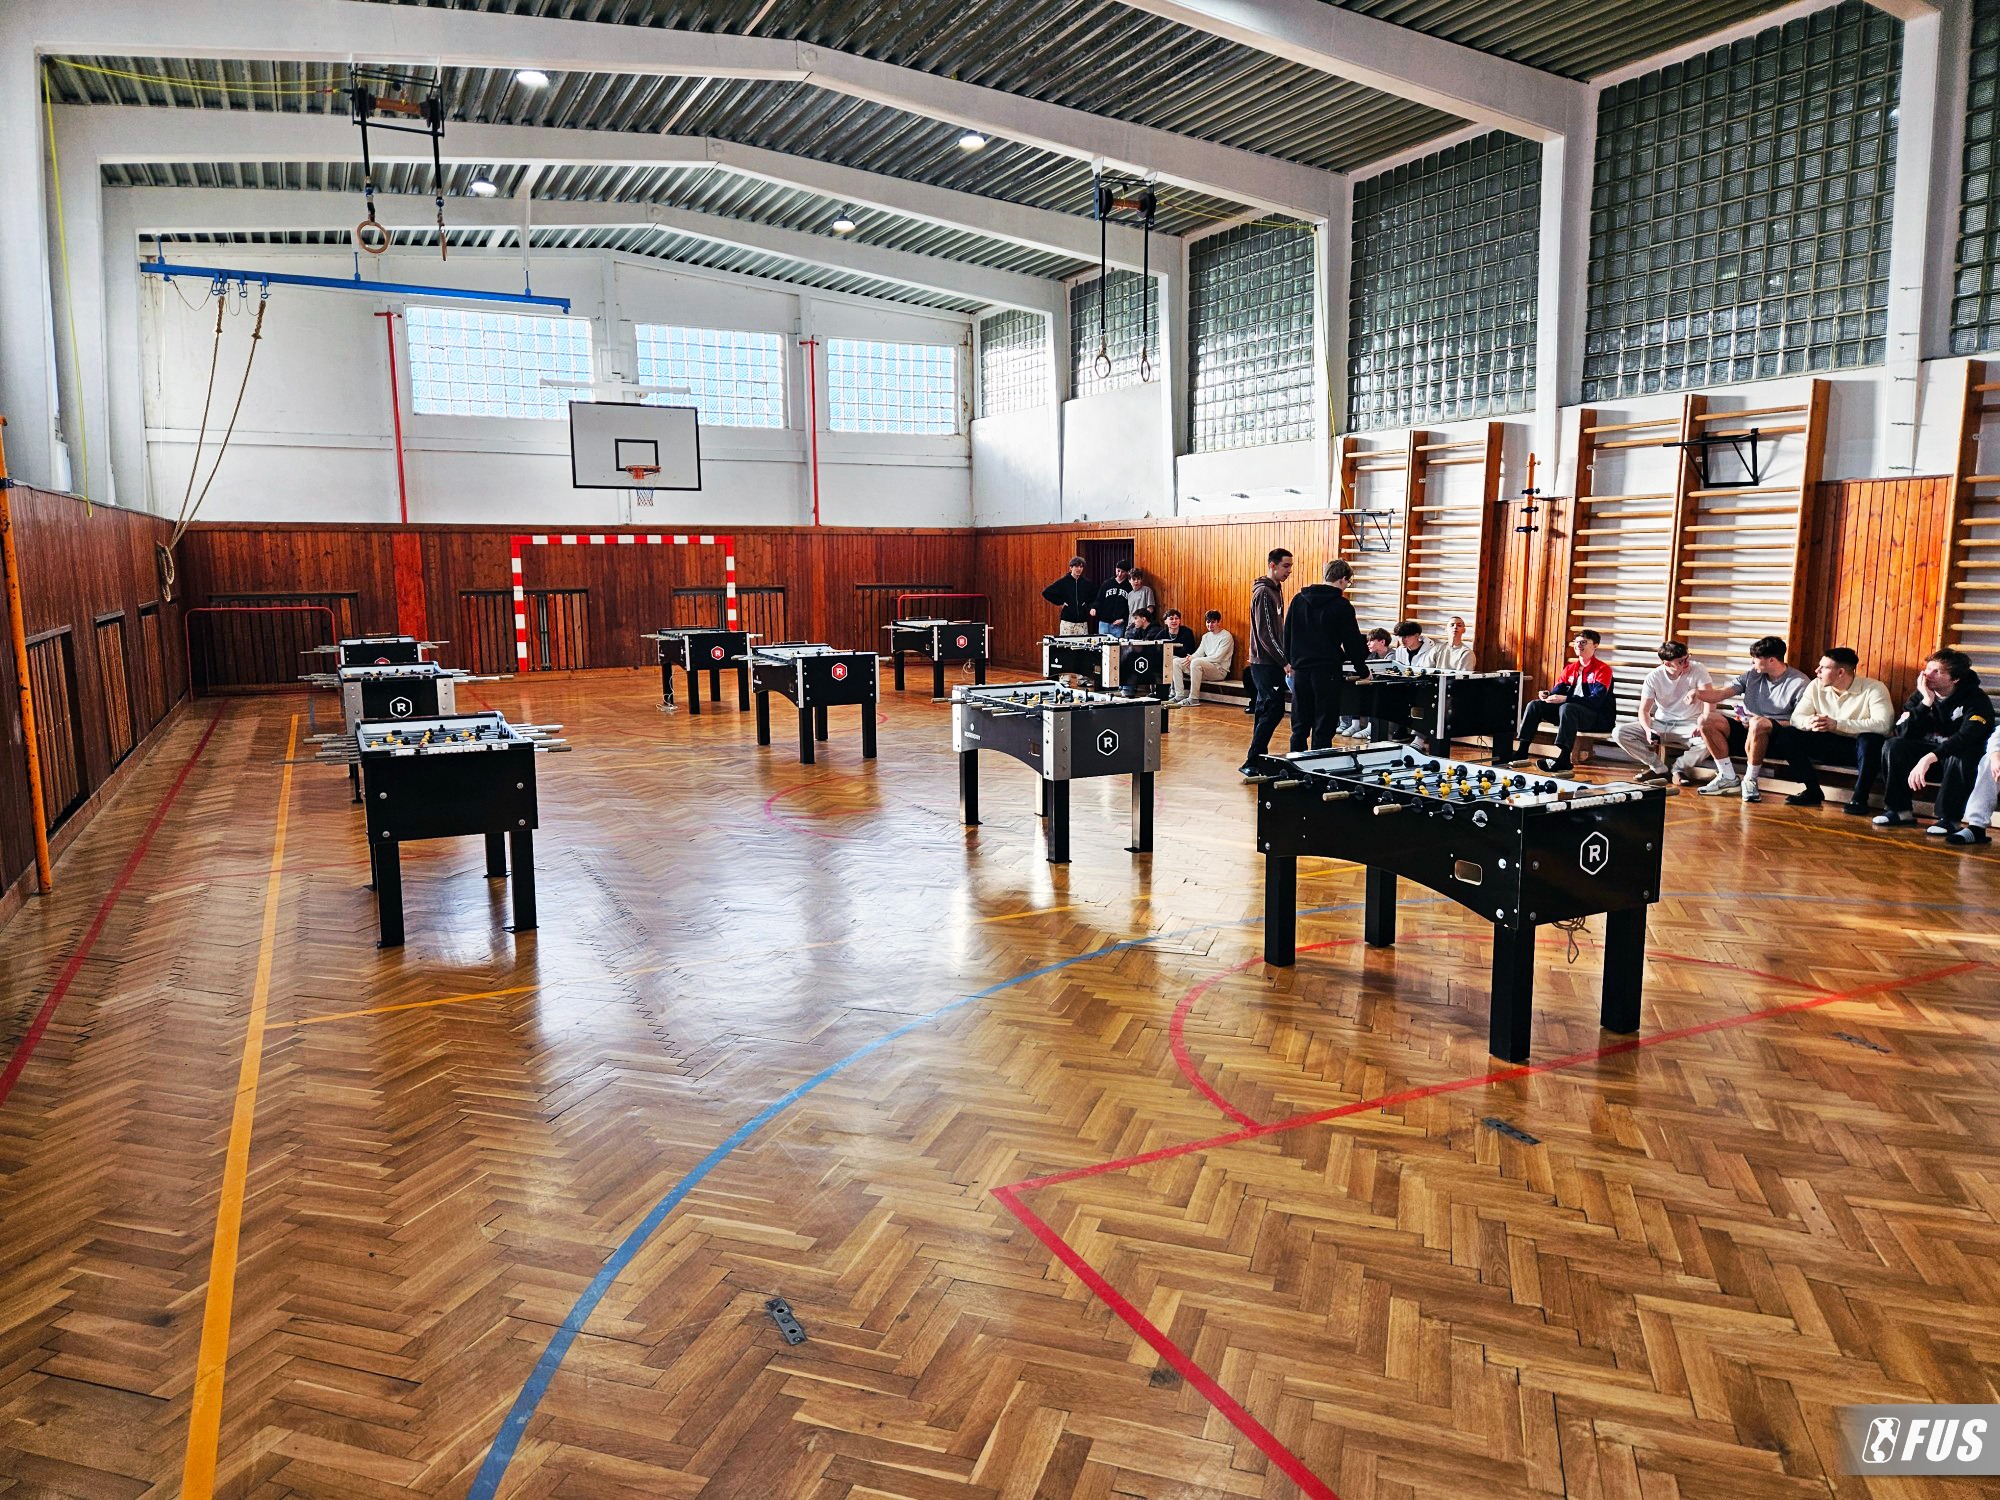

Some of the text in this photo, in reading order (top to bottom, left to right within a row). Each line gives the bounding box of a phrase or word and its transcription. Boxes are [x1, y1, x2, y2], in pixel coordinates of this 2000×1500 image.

[1138, 661, 1145, 669] R
[836, 667, 844, 676] R
[396, 702, 407, 713] R
[1103, 736, 1113, 748] R
[1588, 844, 1601, 863] R
